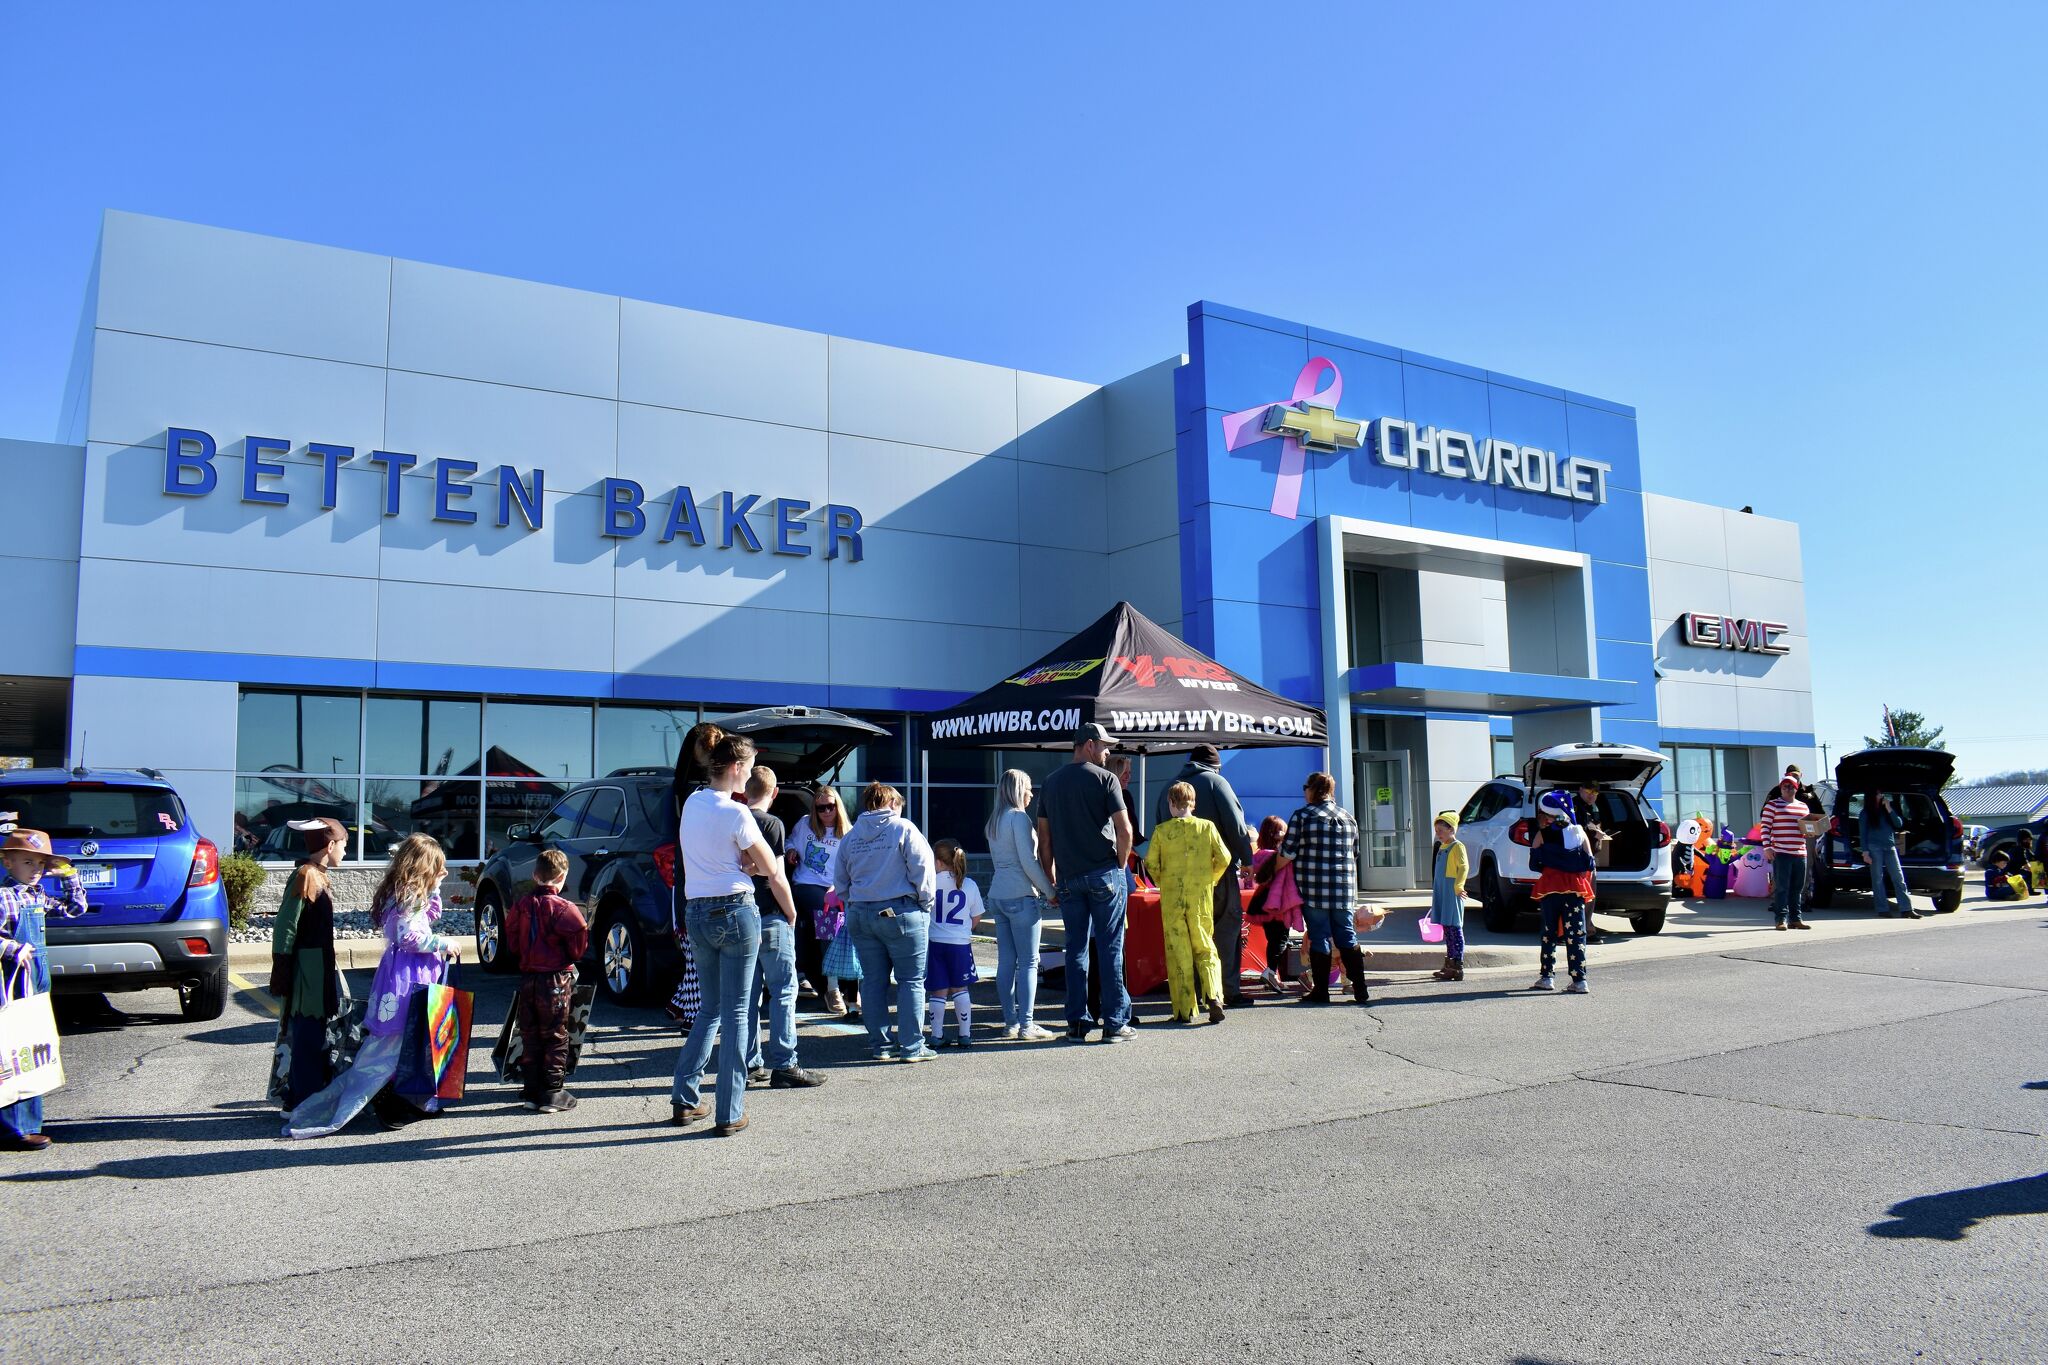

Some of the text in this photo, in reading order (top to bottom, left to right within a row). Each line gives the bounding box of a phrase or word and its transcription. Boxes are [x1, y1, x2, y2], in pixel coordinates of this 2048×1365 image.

[1375, 416, 1612, 504] CHEVROLET
[164, 427, 863, 561] BETTEN BAKER
[1681, 612, 1790, 655] GMC
[1178, 679, 1241, 691] WYBR
[931, 708, 1080, 739] WWW.WWBR.COM
[1111, 710, 1314, 736] WWW.WYBR.COM
[79, 869, 100, 882] BRN
[935, 889, 966, 925] 12
